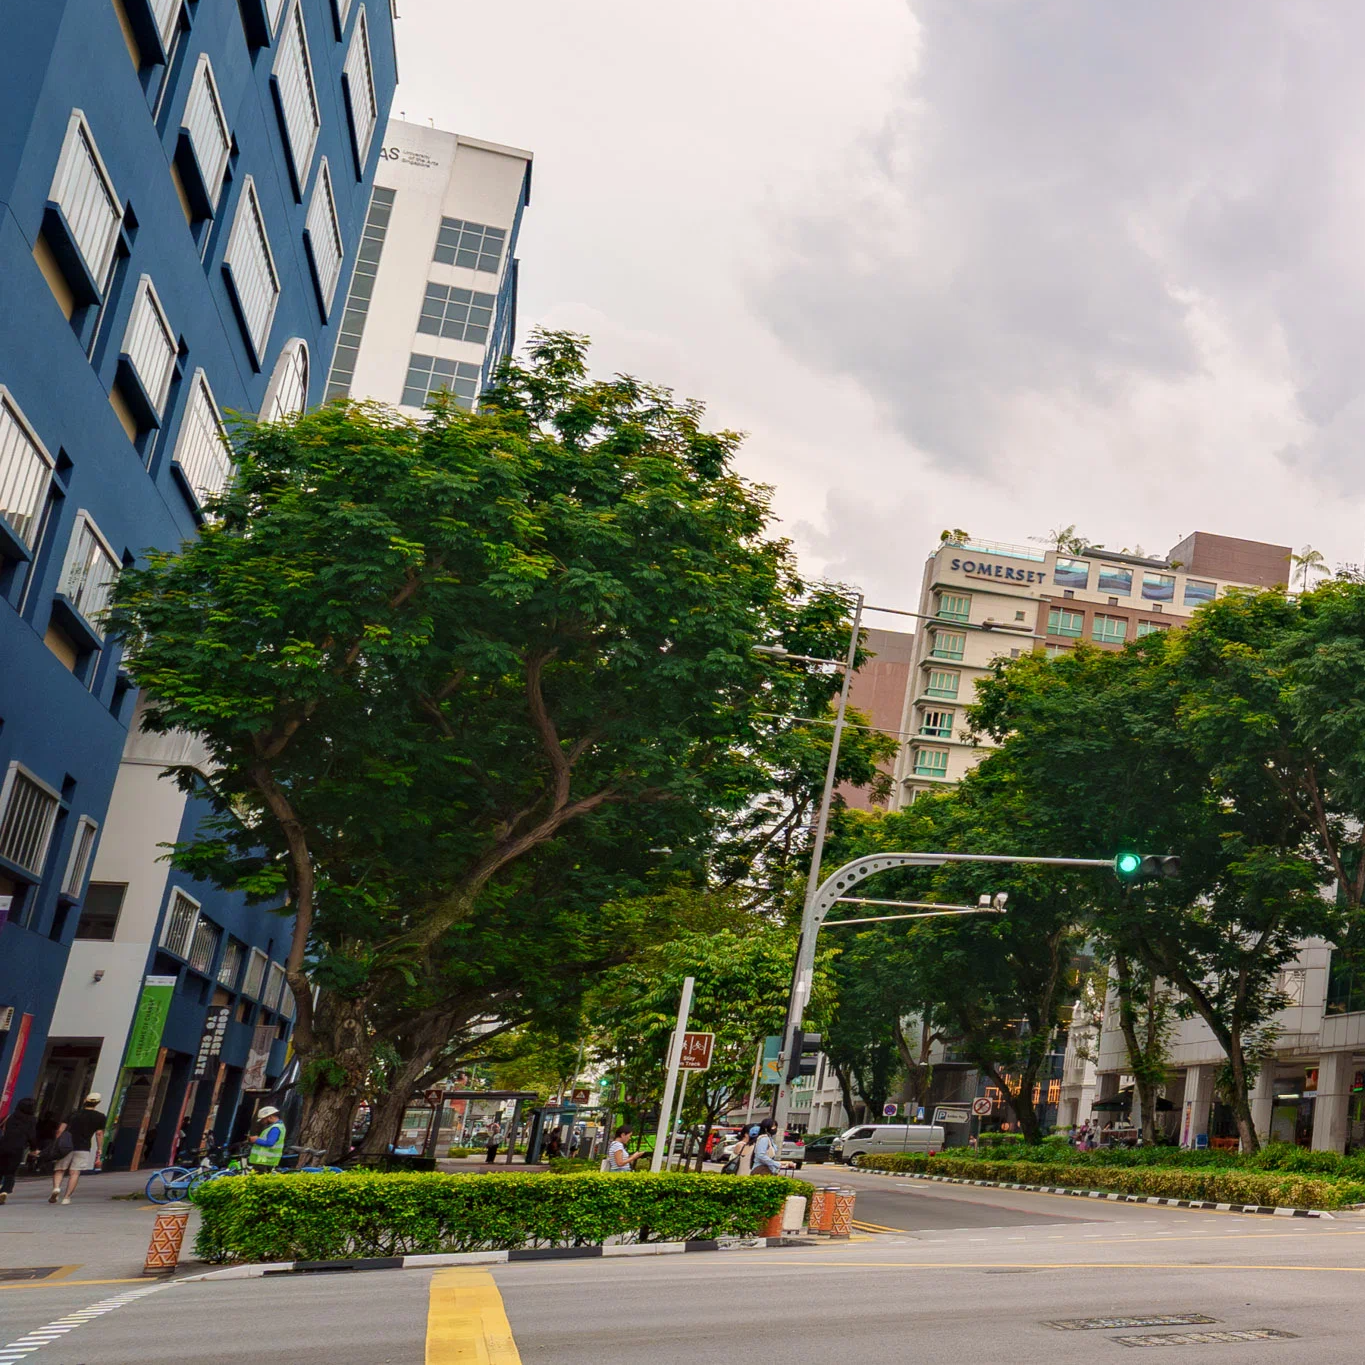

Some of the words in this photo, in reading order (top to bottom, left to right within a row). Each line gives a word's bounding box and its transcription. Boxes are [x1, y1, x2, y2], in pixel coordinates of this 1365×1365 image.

[951, 558, 1046, 583] SOMERSET
[205, 1015, 217, 1029] TO
[209, 1008, 230, 1056] COURAGE
[195, 1035, 213, 1075] CREATE
